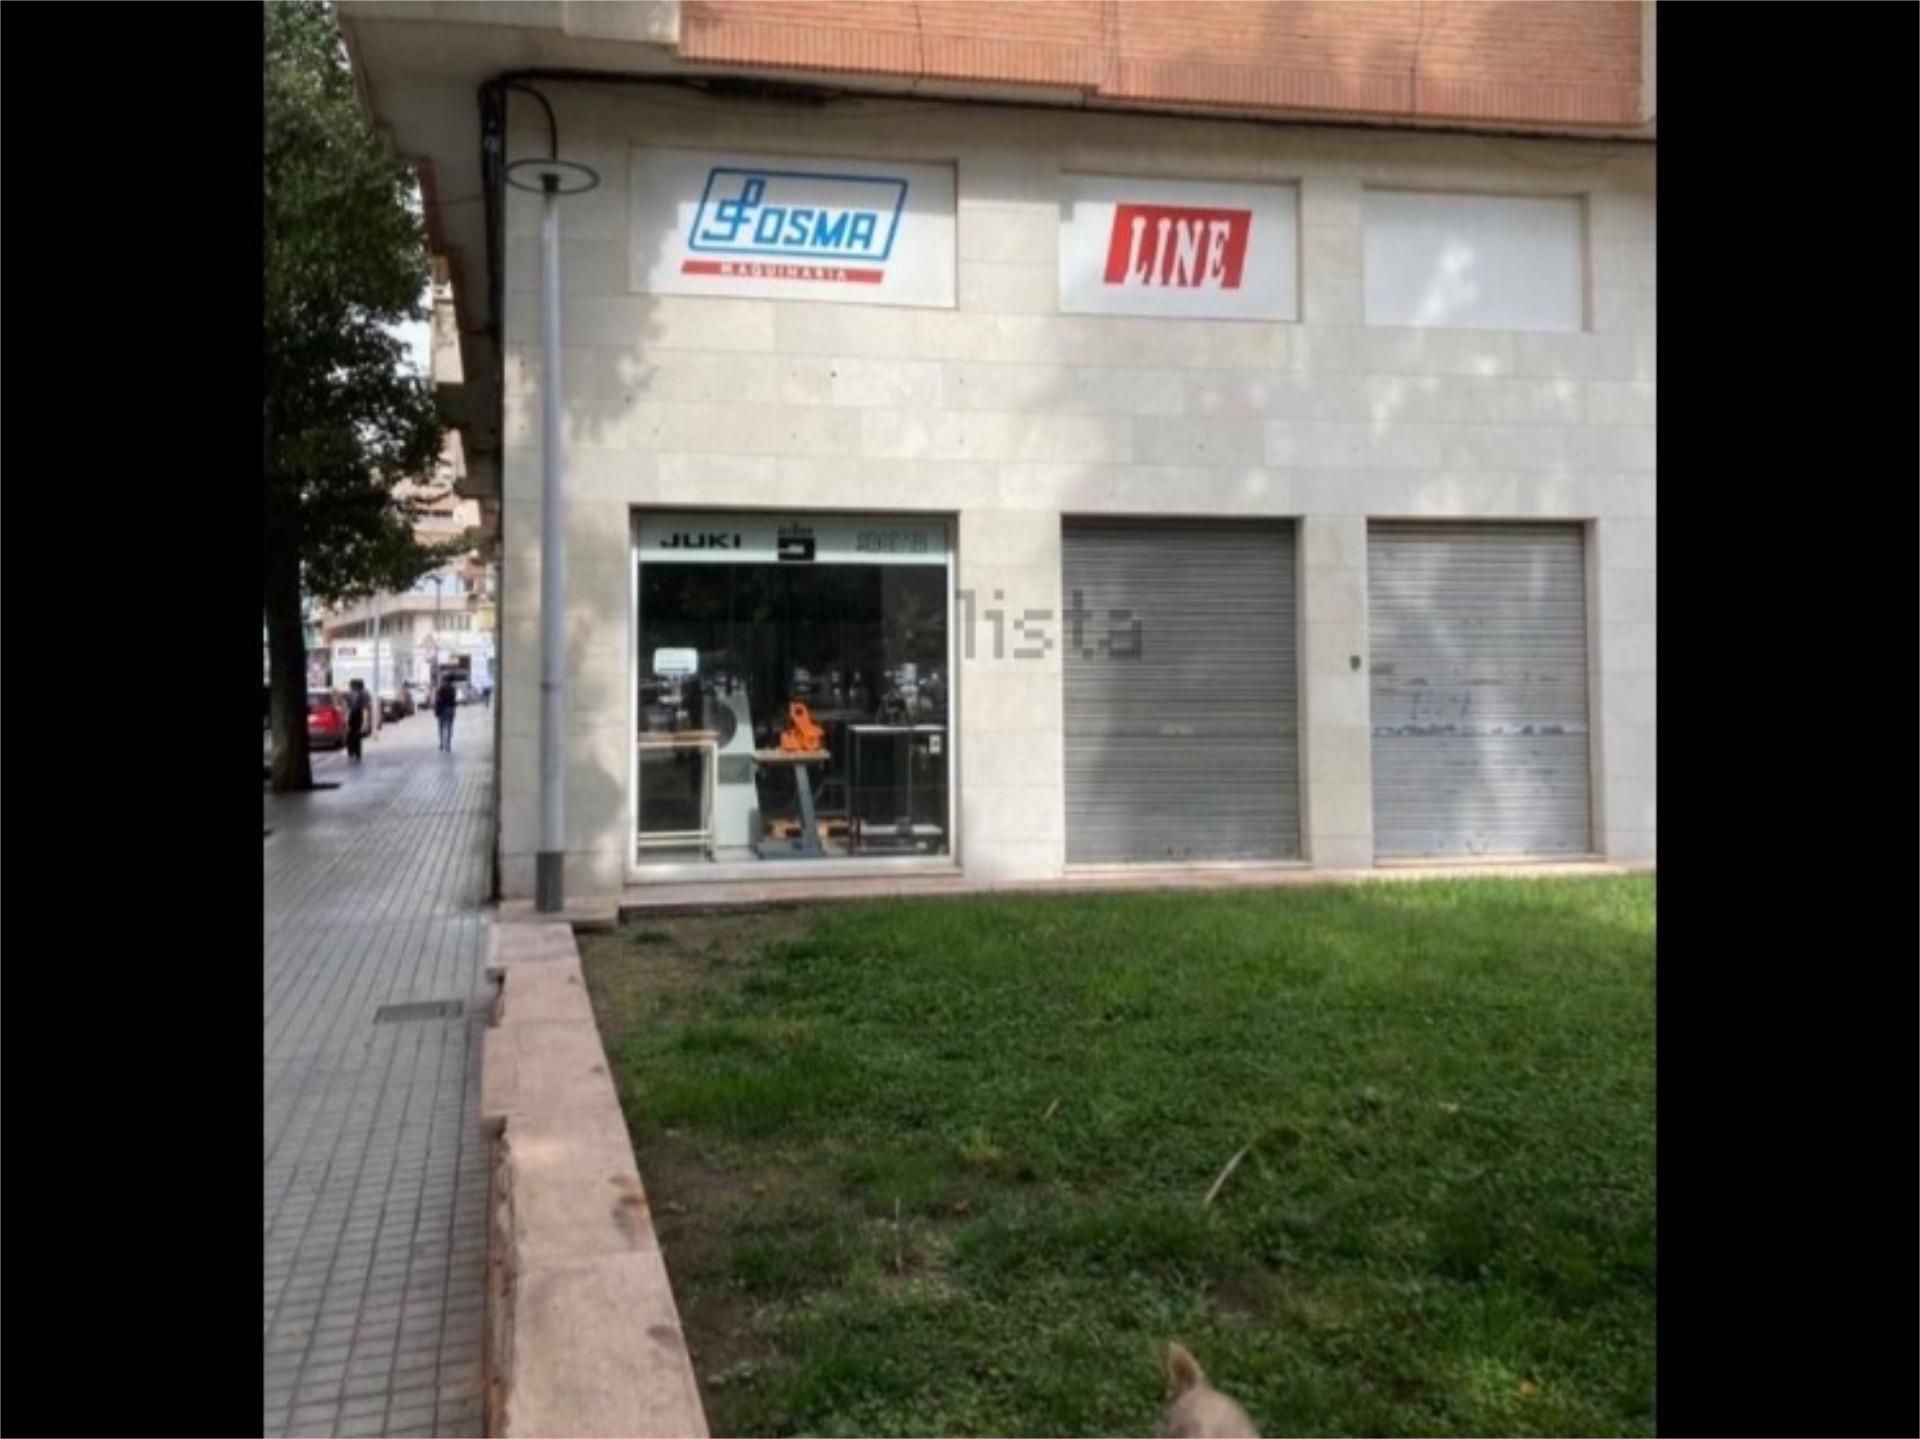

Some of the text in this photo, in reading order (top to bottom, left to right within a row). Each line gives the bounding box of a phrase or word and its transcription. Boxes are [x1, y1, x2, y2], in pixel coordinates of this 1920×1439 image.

[1122, 216, 1231, 288] LINE
[720, 261, 848, 281] MAQUINARIA
[660, 532, 741, 549] JUKI
